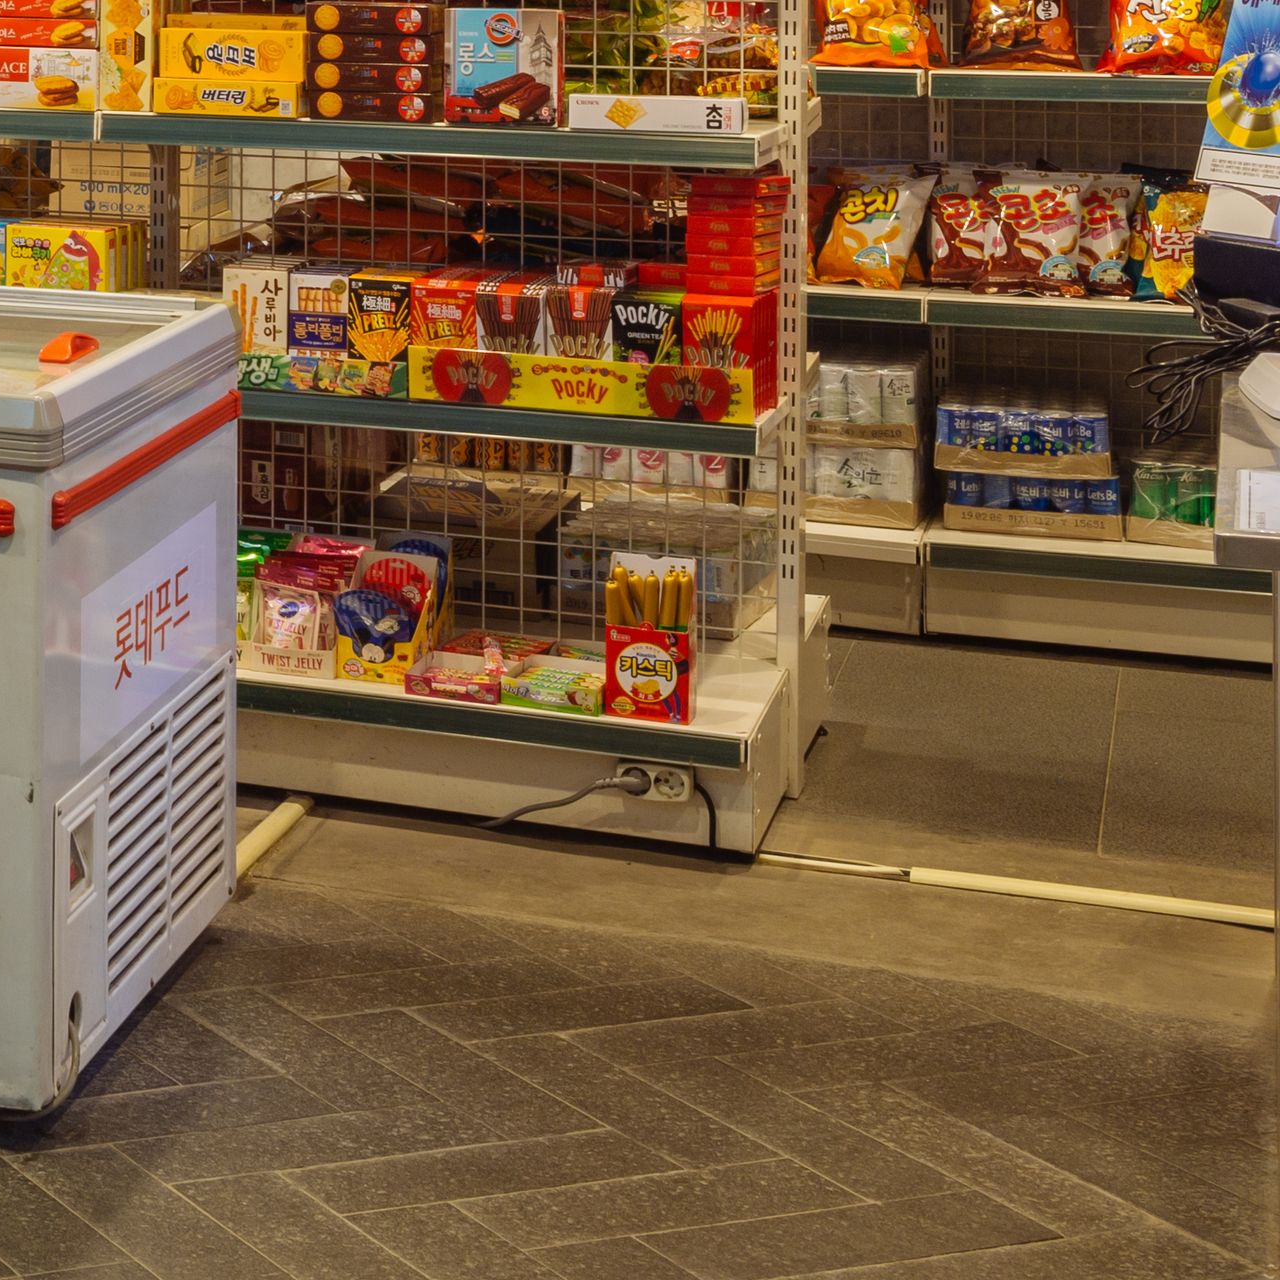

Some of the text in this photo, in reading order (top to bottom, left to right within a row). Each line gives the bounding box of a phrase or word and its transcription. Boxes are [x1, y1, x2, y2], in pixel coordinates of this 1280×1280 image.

[204, 42, 256, 69] 버터링
[458, 42, 497, 76] 롱스
[199, 89, 247, 105] 버터링
[80, 181, 104, 193] 500
[840, 184, 900, 223] 콘치
[996, 188, 1075, 233] 콘초
[11, 247, 52, 260] 라바쿠키
[260, 278, 284, 342] 사루비아
[293, 321, 344, 342] 롤리폴리
[627, 331, 653, 339] GREEN
[113, 564, 191, 690] 롯데푸드
[261, 651, 323, 671] TWIST JELLY
[619, 655, 673, 681] 키스틱
